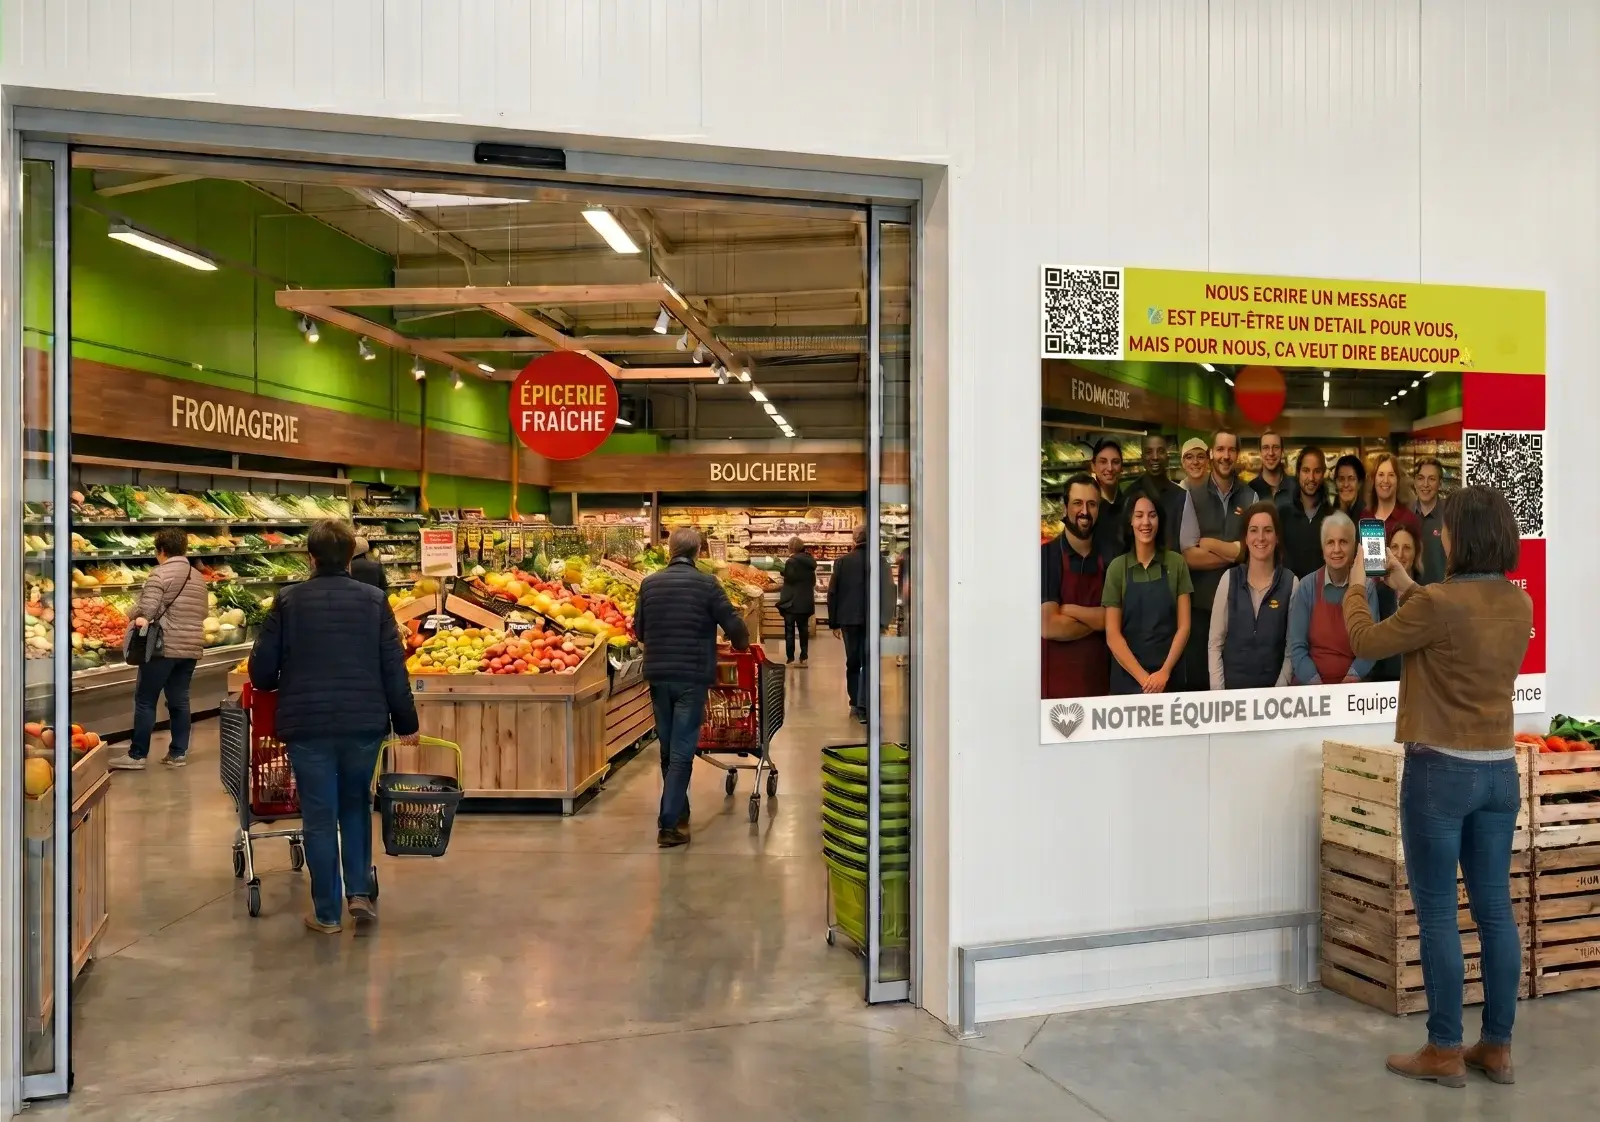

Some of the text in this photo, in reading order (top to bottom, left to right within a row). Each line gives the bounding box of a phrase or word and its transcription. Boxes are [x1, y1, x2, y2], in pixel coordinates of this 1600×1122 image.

[1205, 283, 1407, 309] NOUS ECRIRE UN MESSAGE
[1167, 308, 1459, 341] EST PEUT-ÊTRE UN DETAIL POUR VOUS,
[1129, 335, 1170, 354] MAIS
[1174, 337, 1218, 355] POUR
[1222, 339, 1272, 359] NOUS,
[1274, 341, 1296, 358] CA
[1298, 342, 1338, 360] VEUT
[1342, 344, 1377, 361] DIRE
[520, 380, 607, 406] ÉPICERIE
[172, 394, 299, 444] FROMAGERIE
[521, 405, 606, 432] FRAÎCHE
[710, 462, 817, 482] BOUCHERIE
[1091, 692, 1397, 730] NOTRE ÉQUIPE LOCALE Equipe
